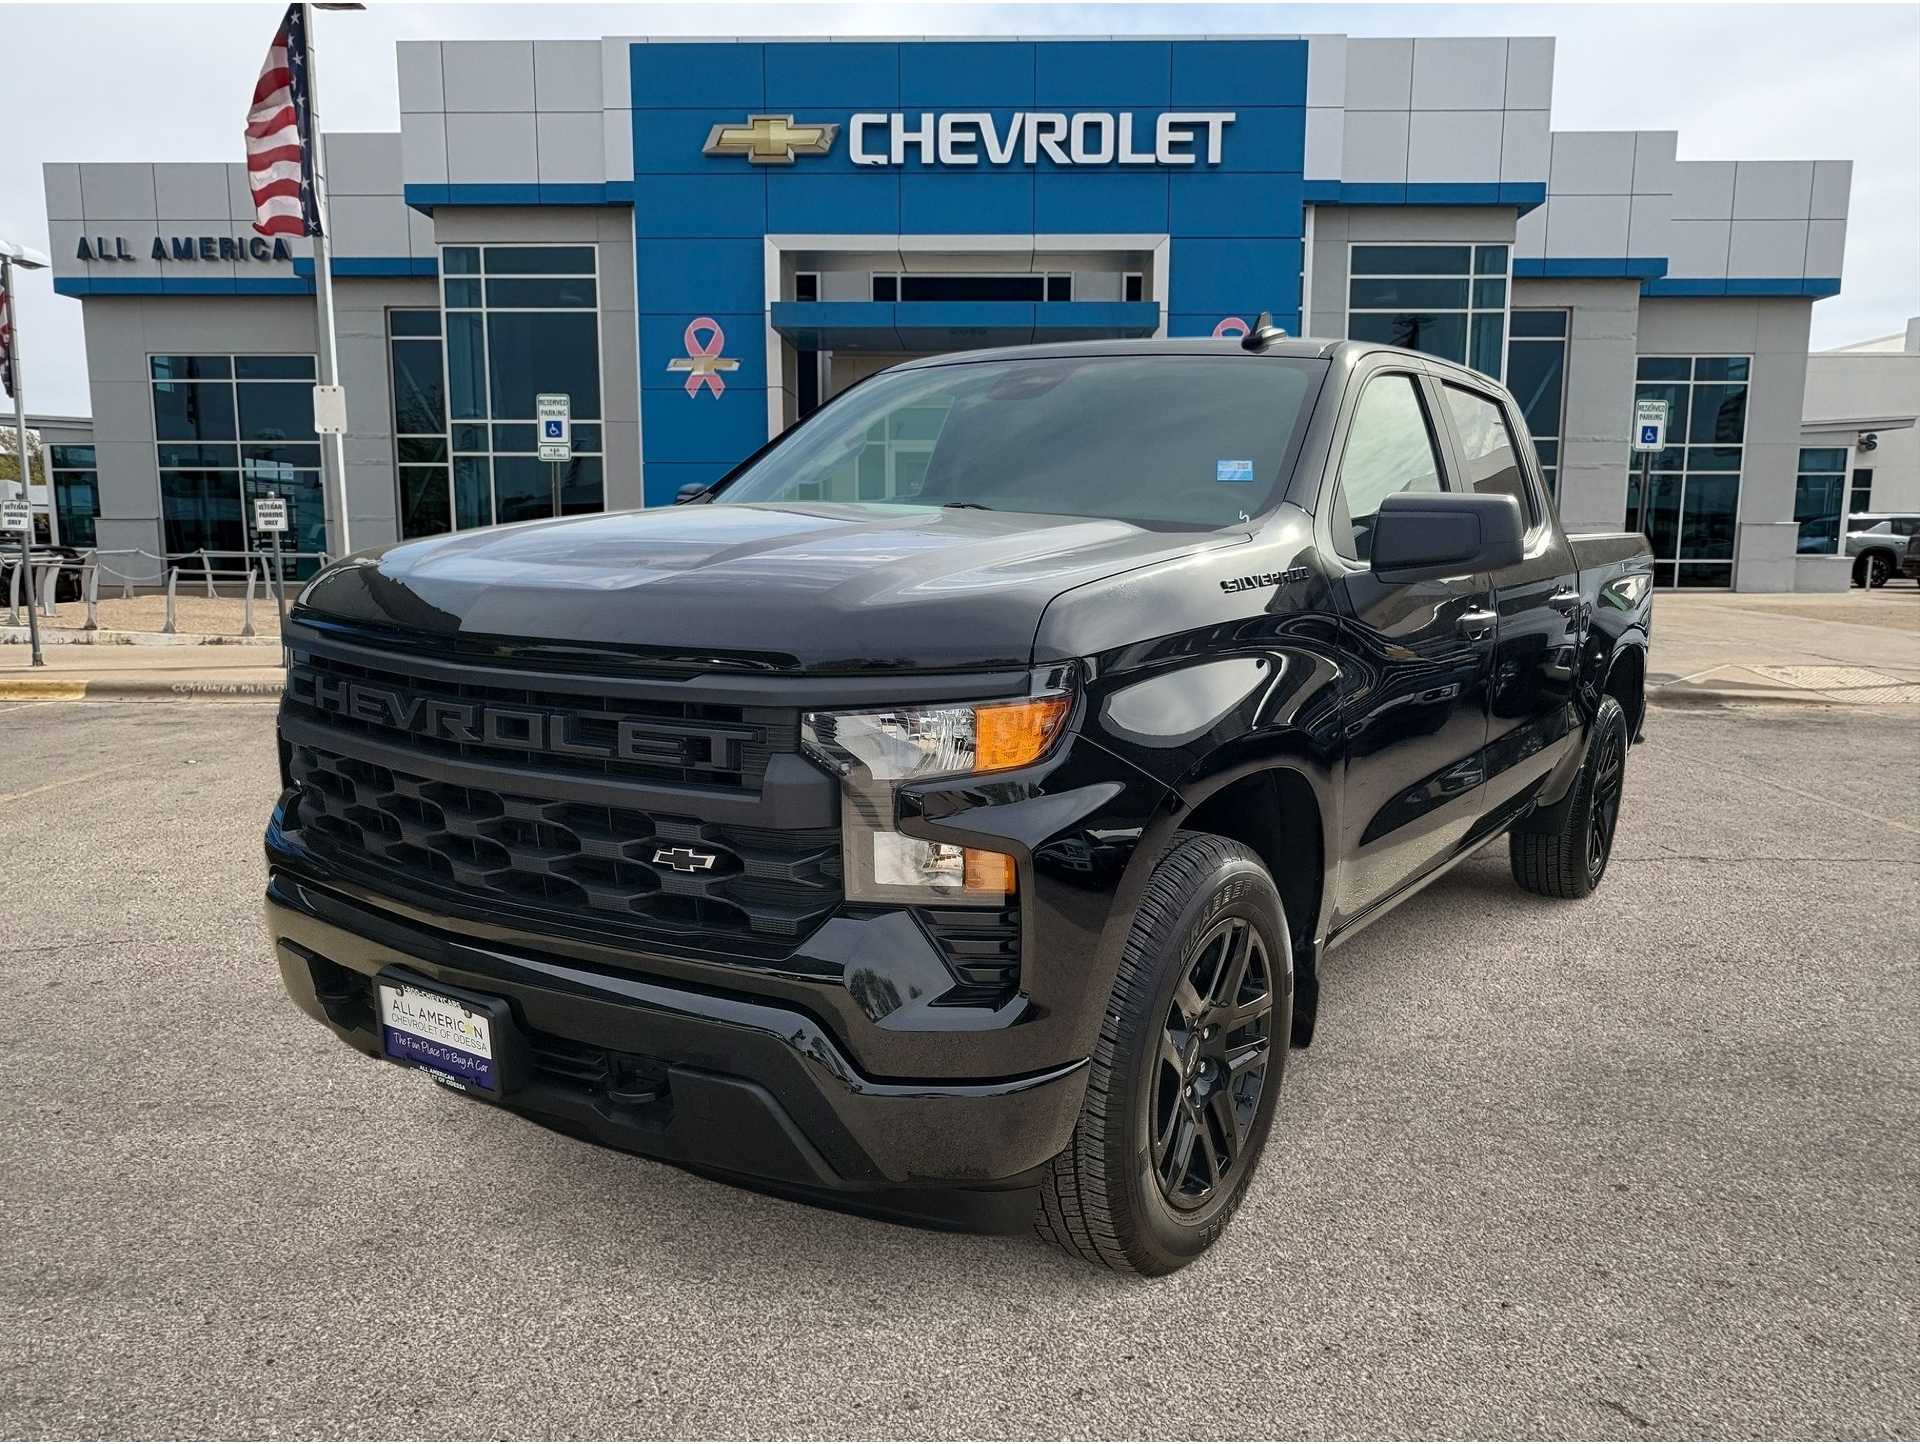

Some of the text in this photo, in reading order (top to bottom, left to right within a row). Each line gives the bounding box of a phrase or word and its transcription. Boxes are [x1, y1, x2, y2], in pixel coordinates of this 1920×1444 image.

[848, 111, 1237, 167] CHEVROLET
[76, 236, 134, 261] ALL
[1220, 566, 1312, 594] SILVERADO
[287, 675, 767, 770] CHEVROLET
[391, 1012, 489, 1052] CHEVROLET OF ODESSA
[392, 999, 483, 1040] ALL AMERICN
[393, 1032, 489, 1073] The Fun Place To Buy A Car
